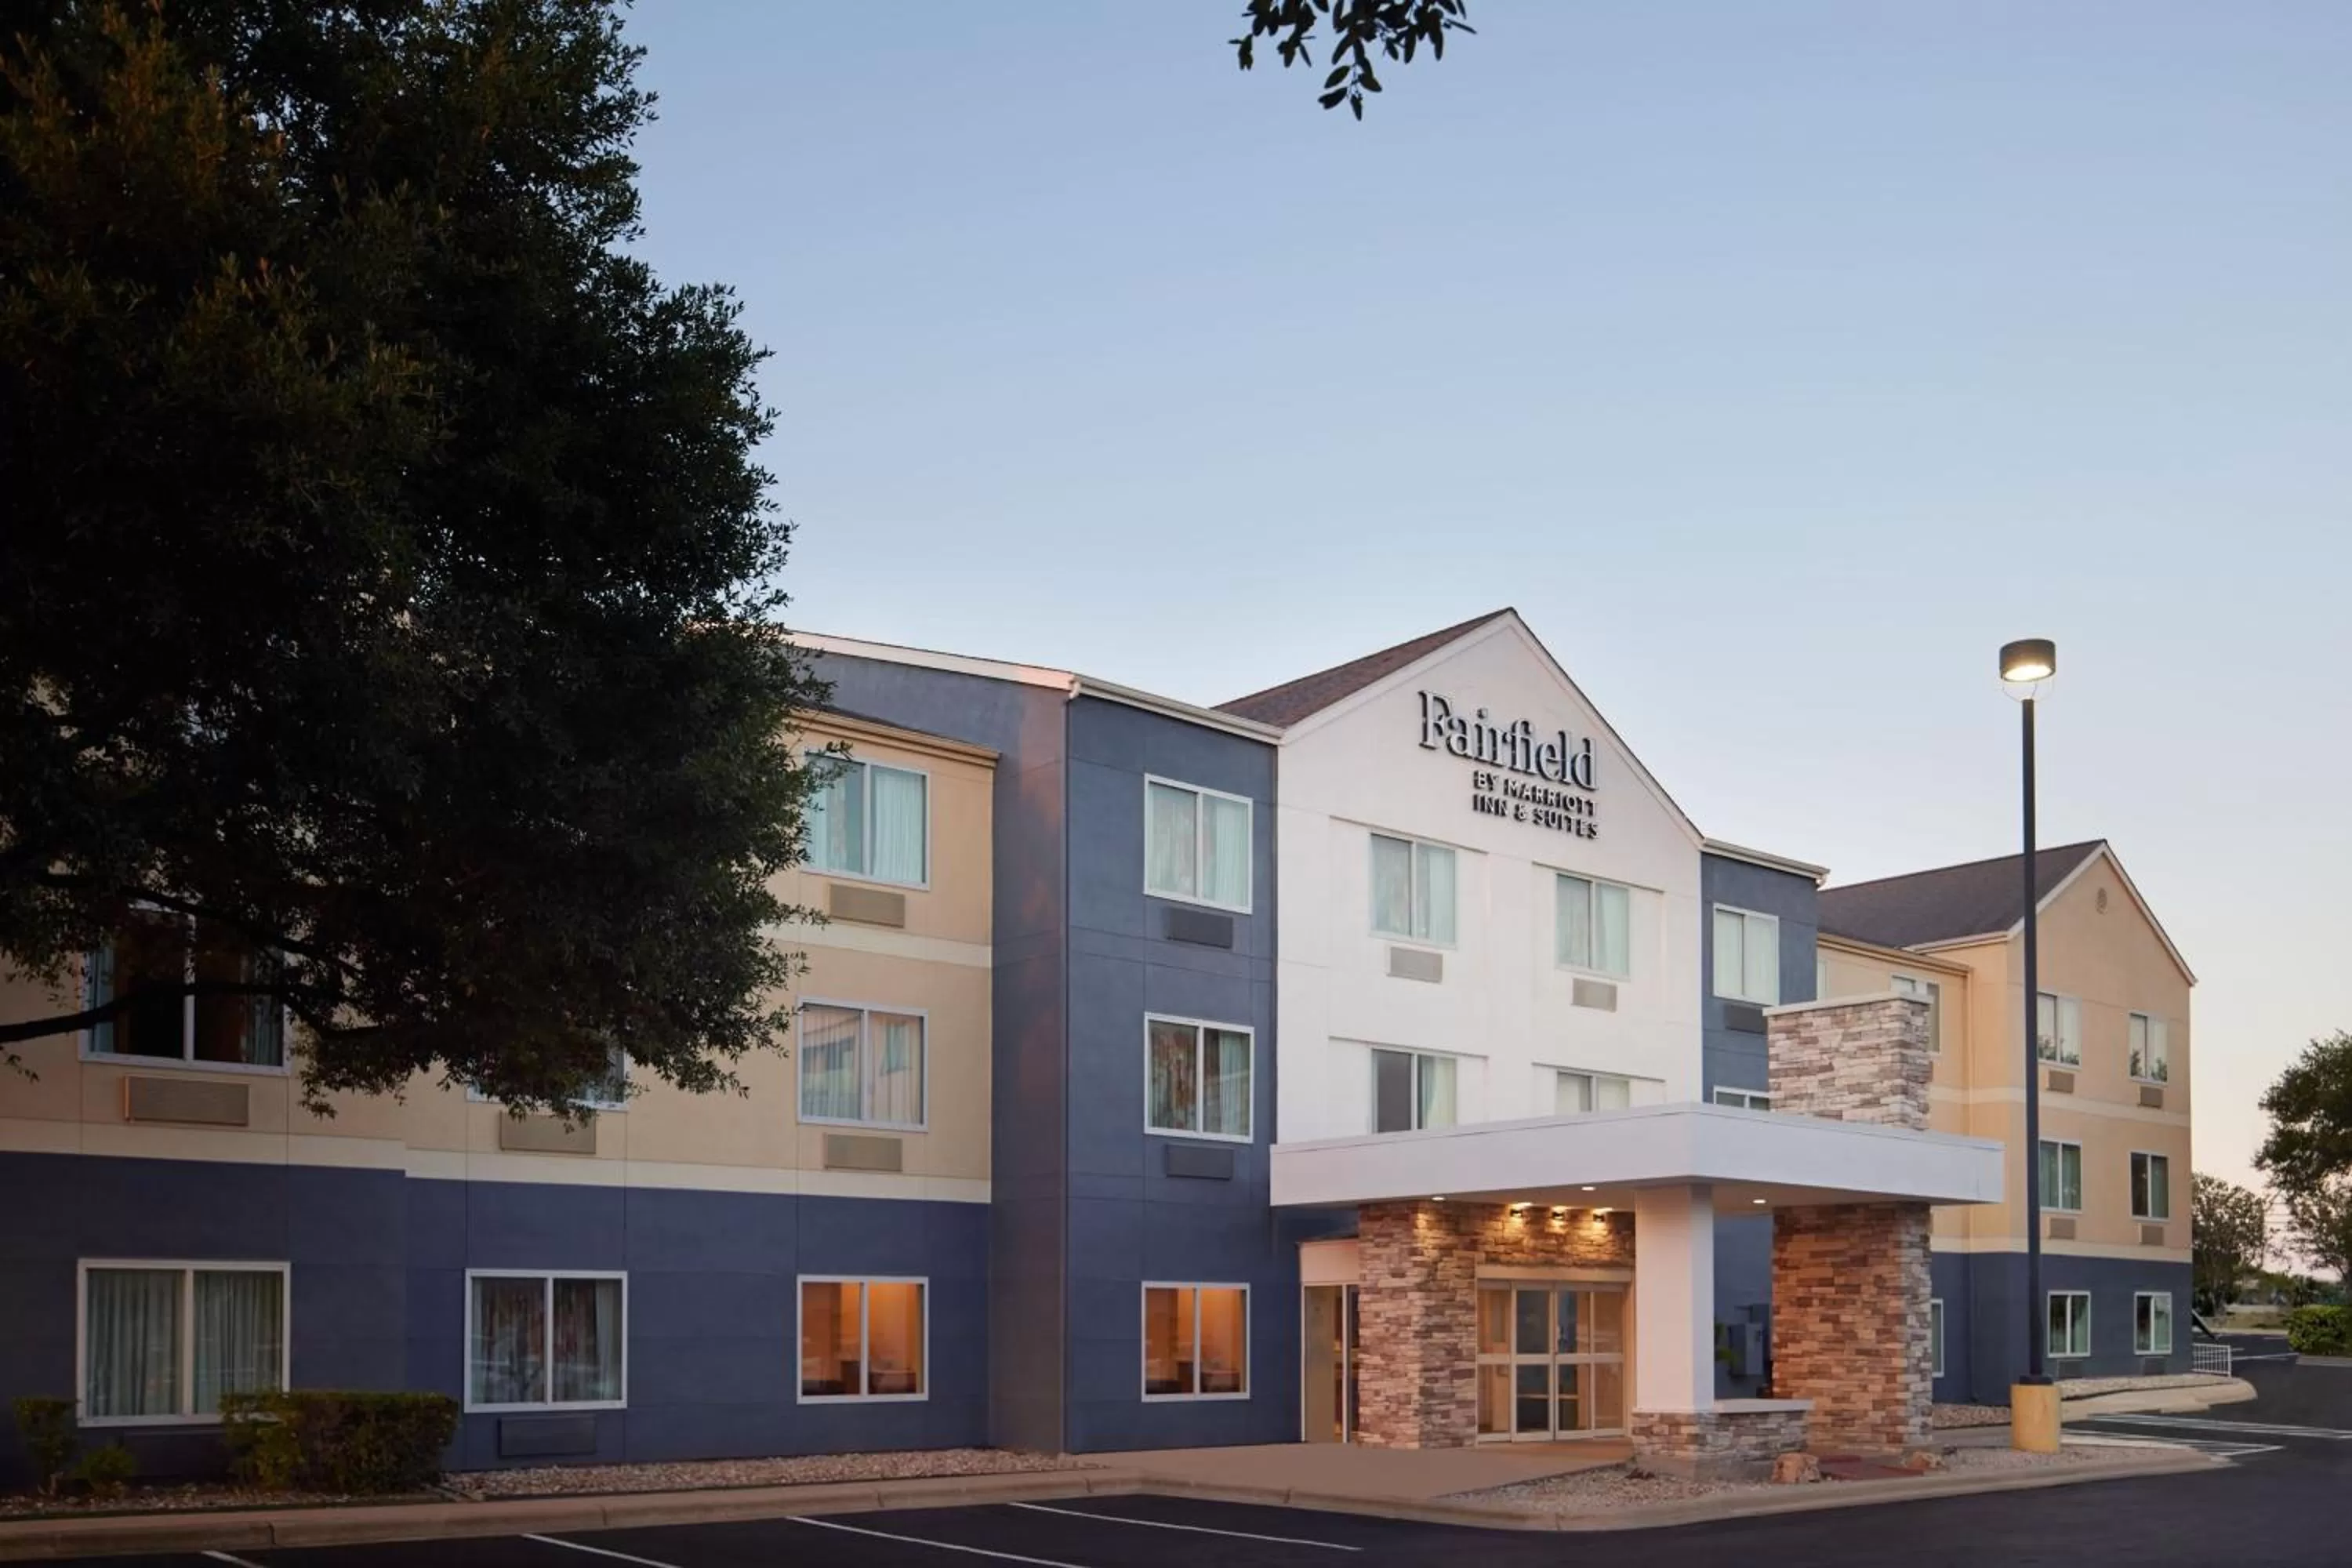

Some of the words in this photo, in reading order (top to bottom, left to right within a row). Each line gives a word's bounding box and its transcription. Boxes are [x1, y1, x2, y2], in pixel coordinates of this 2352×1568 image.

[1417, 690, 1599, 791] Fairfield
[1472, 771, 1497, 791] BY
[1503, 779, 1597, 816] MARRIOTT
[1472, 794, 1508, 817] INN
[1513, 803, 1527, 822] &
[1533, 808, 1599, 840] SUITES
